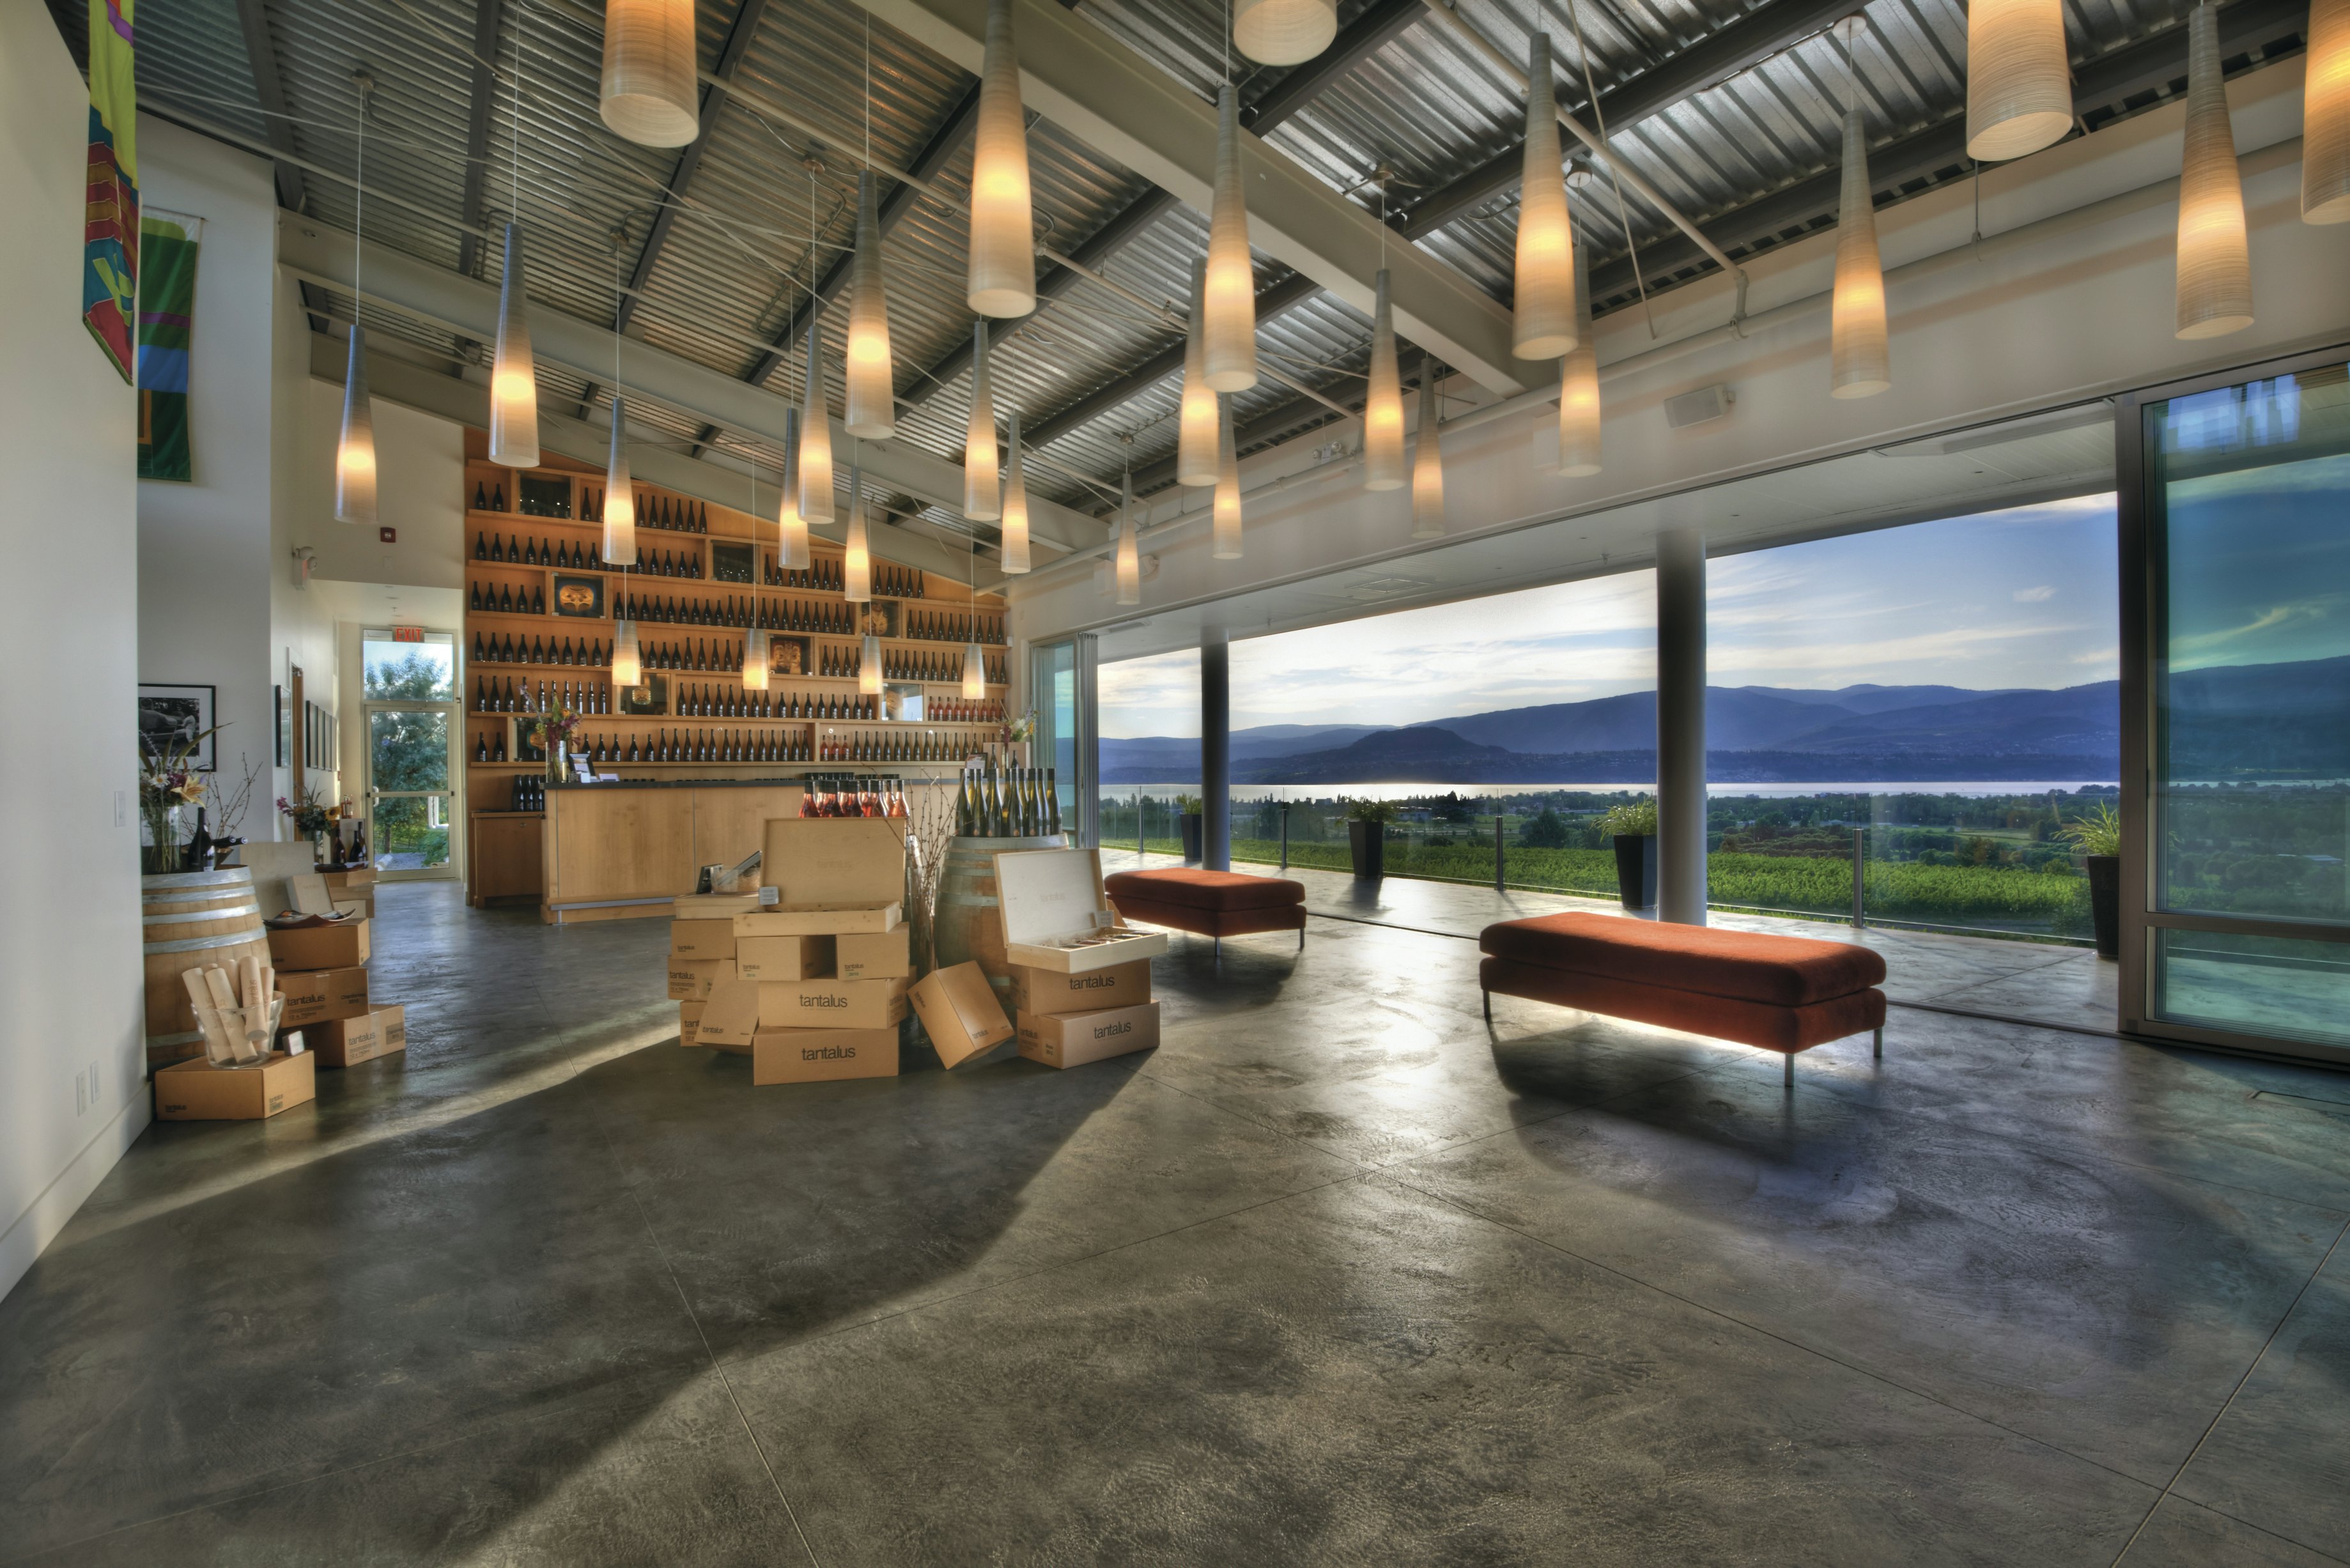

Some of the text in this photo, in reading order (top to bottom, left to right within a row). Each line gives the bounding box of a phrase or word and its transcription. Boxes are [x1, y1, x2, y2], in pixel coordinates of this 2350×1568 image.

[396, 628, 422, 642] EXIT
[670, 971, 695, 980] tantalus
[1069, 975, 1115, 990] tantalus
[286, 995, 325, 1006] tantalus
[799, 994, 847, 1008] tantalus
[1094, 1021, 1131, 1039] tantalus
[348, 1033, 376, 1045] tantalus
[801, 1045, 856, 1061] tantalus
